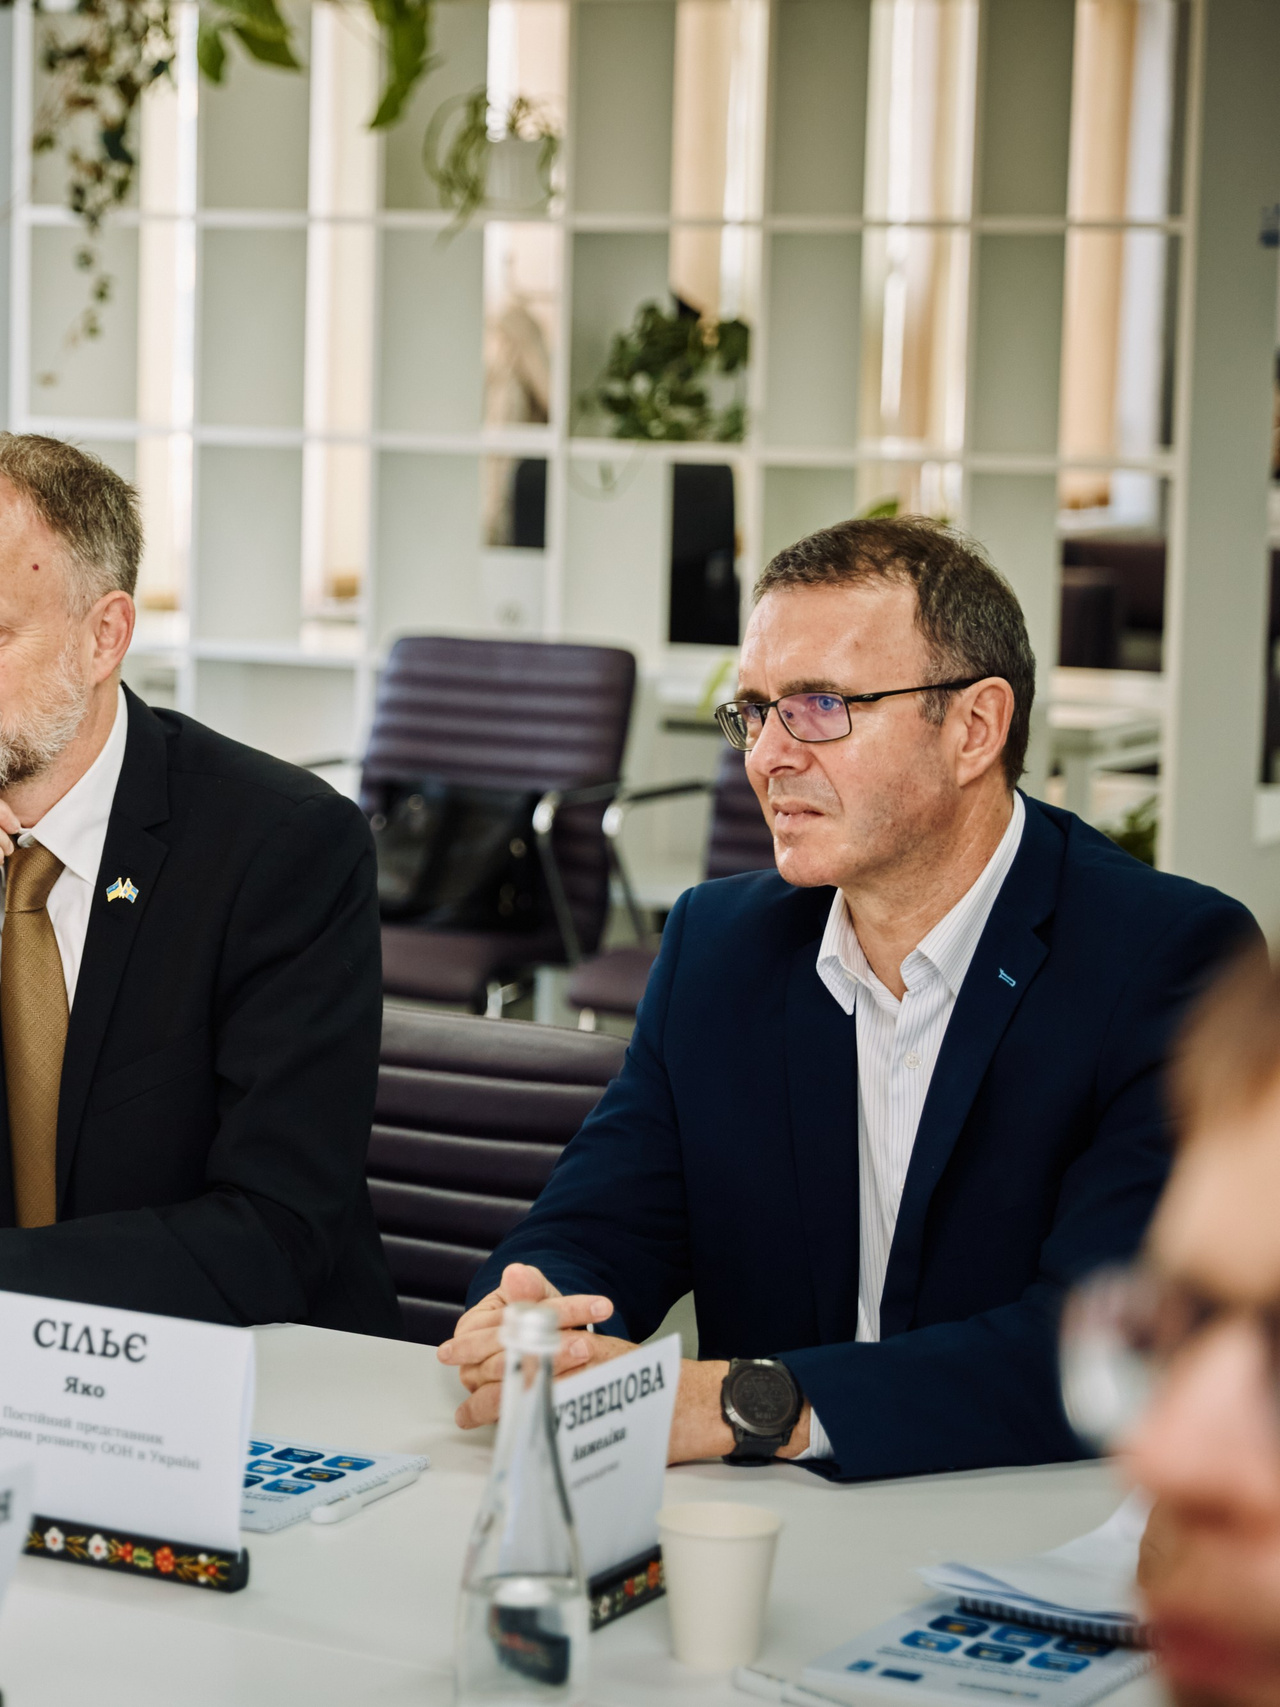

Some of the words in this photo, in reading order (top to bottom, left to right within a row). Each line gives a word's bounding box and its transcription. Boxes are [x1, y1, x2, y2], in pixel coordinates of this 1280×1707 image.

[32, 1318, 149, 1363] СІЛЬЄ
[63, 1376, 106, 1398] Яко
[2, 1406, 72, 1430] Постійний
[76, 1420, 164, 1446] представник
[36, 1432, 96, 1454] розвитку
[100, 1441, 134, 1459] ООН
[149, 1448, 201, 1471] Україні
